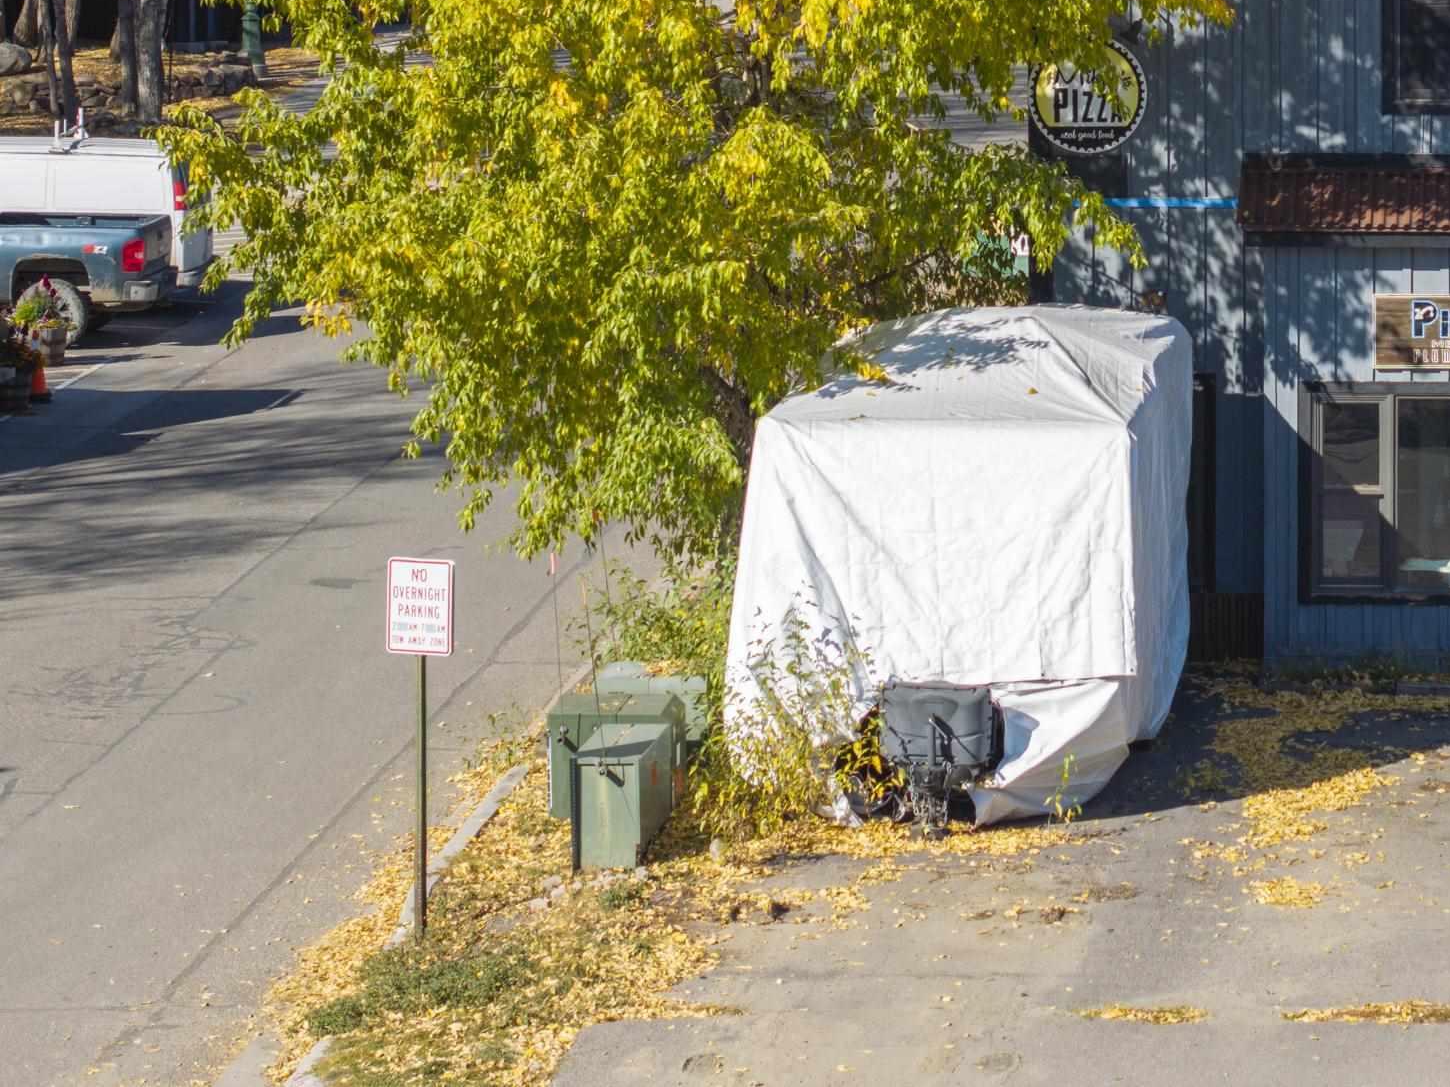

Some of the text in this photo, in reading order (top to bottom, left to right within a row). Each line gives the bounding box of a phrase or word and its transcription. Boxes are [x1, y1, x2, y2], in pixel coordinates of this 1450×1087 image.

[411, 568, 428, 583] NO
[392, 585, 447, 602] OVERNIGHT
[397, 603, 441, 619] PARKING
